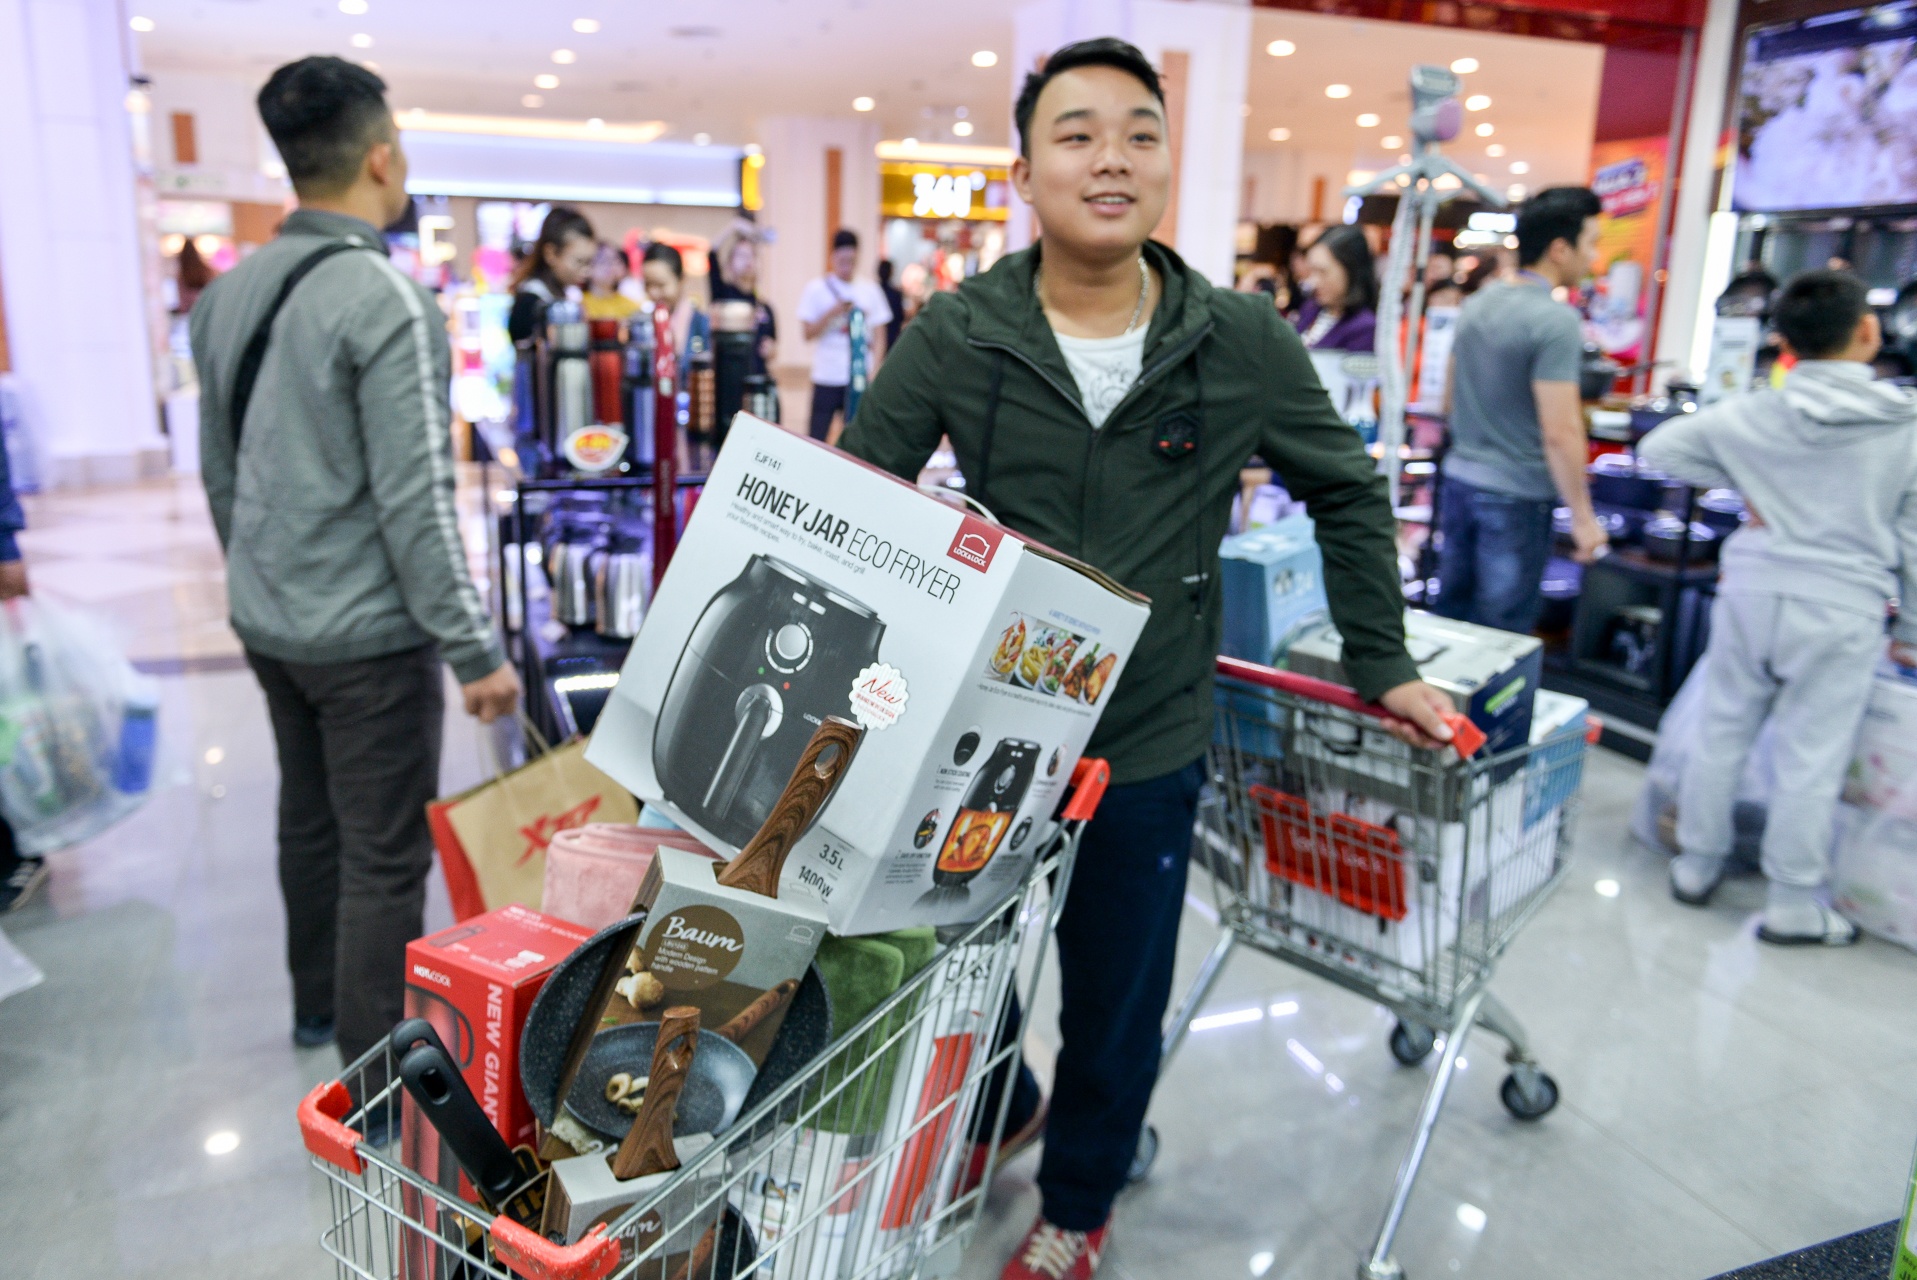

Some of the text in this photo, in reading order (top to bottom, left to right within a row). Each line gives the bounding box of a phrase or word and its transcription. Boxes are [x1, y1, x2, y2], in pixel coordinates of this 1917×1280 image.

[754, 451, 782, 471] EJF141
[737, 473, 961, 605] HONEY JAR ECO FRYER
[953, 547, 987, 567] LOCK&LOCK
[861, 677, 902, 704] New
[662, 915, 744, 952] Baum
[486, 983, 503, 1049] NEW
